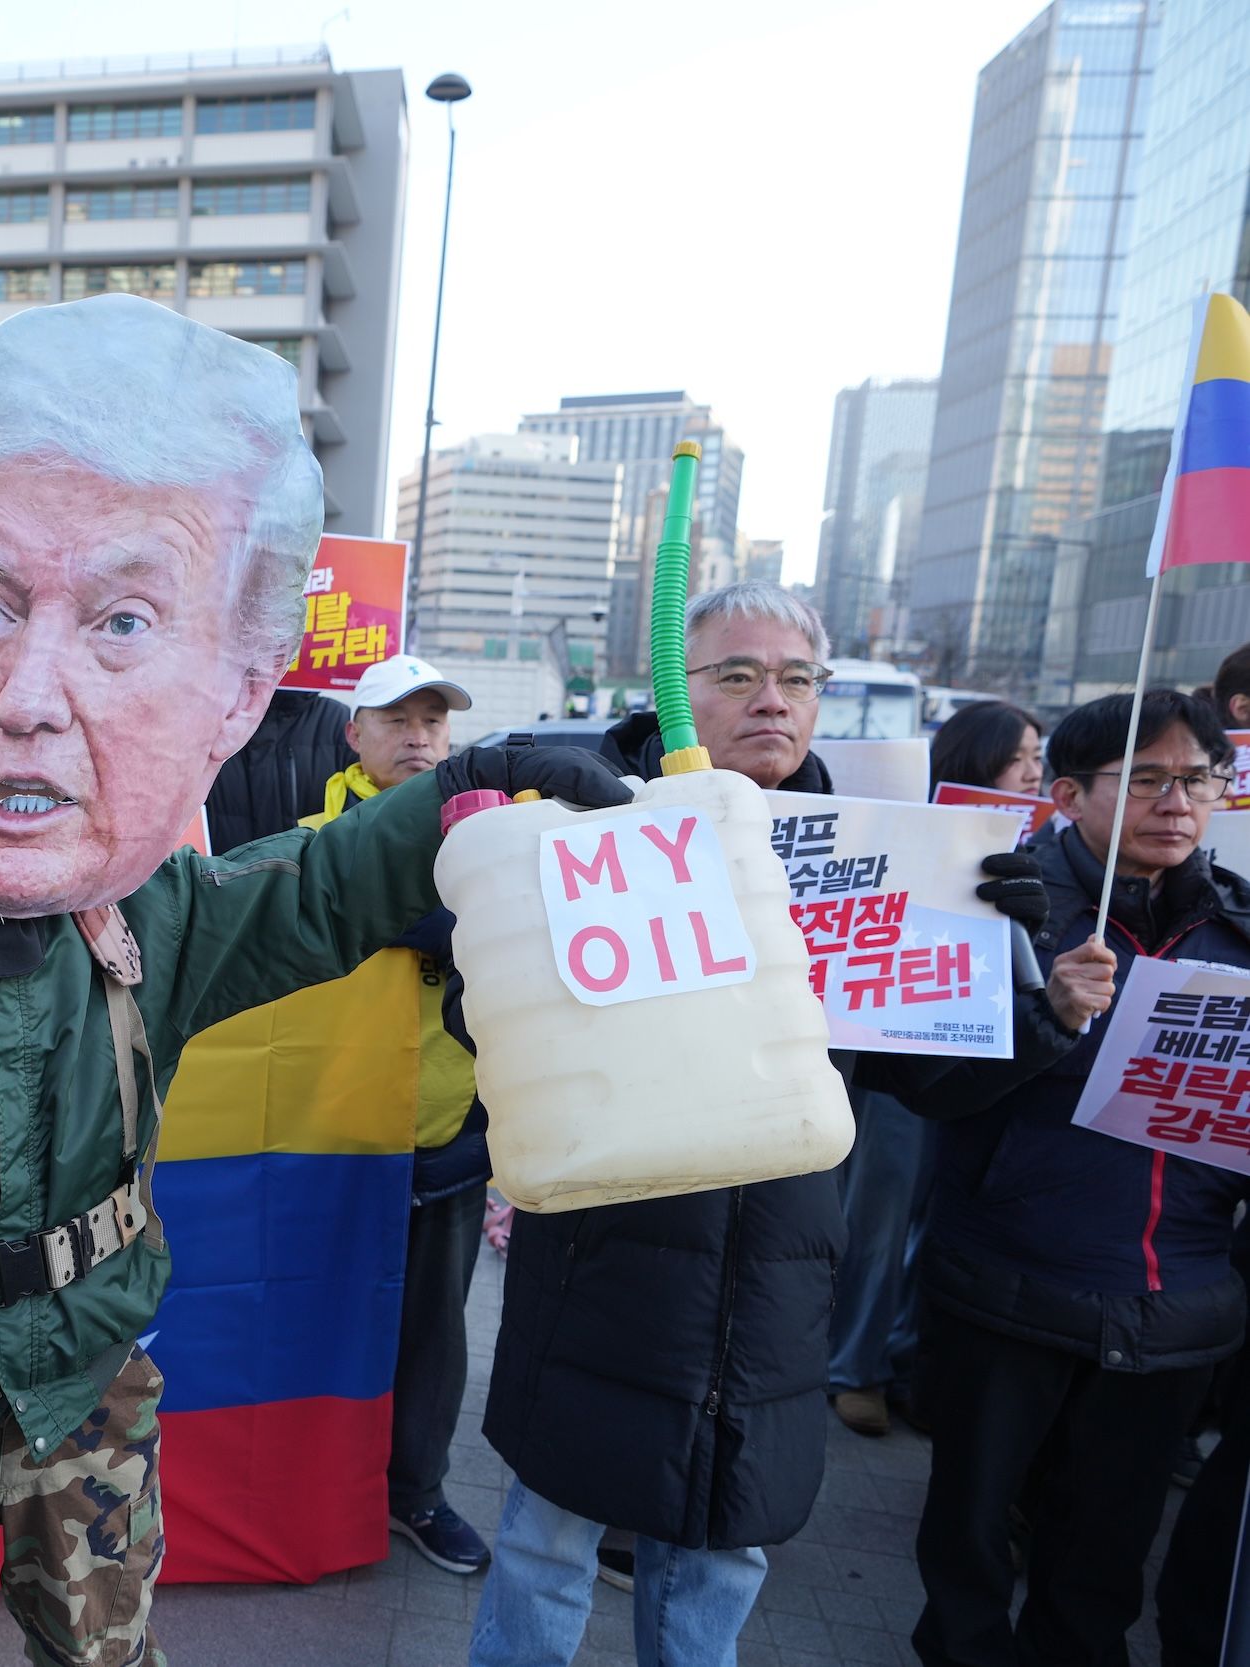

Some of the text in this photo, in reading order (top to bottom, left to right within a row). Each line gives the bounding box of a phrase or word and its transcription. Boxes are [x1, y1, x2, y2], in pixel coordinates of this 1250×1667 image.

[310, 624, 387, 669] 규탄!
[553, 816, 697, 902] MY
[769, 812, 839, 860] 럼프
[784, 854, 889, 898] 수엘라
[789, 891, 909, 956] 전쟁
[568, 911, 747, 993] OIL
[843, 942, 971, 1011] 규탄!
[933, 1021, 960, 1032] 트럼프
[976, 1024, 994, 1034] 규탄
[1147, 992, 1250, 1031] 트럼
[1119, 1056, 1250, 1113] 침략
